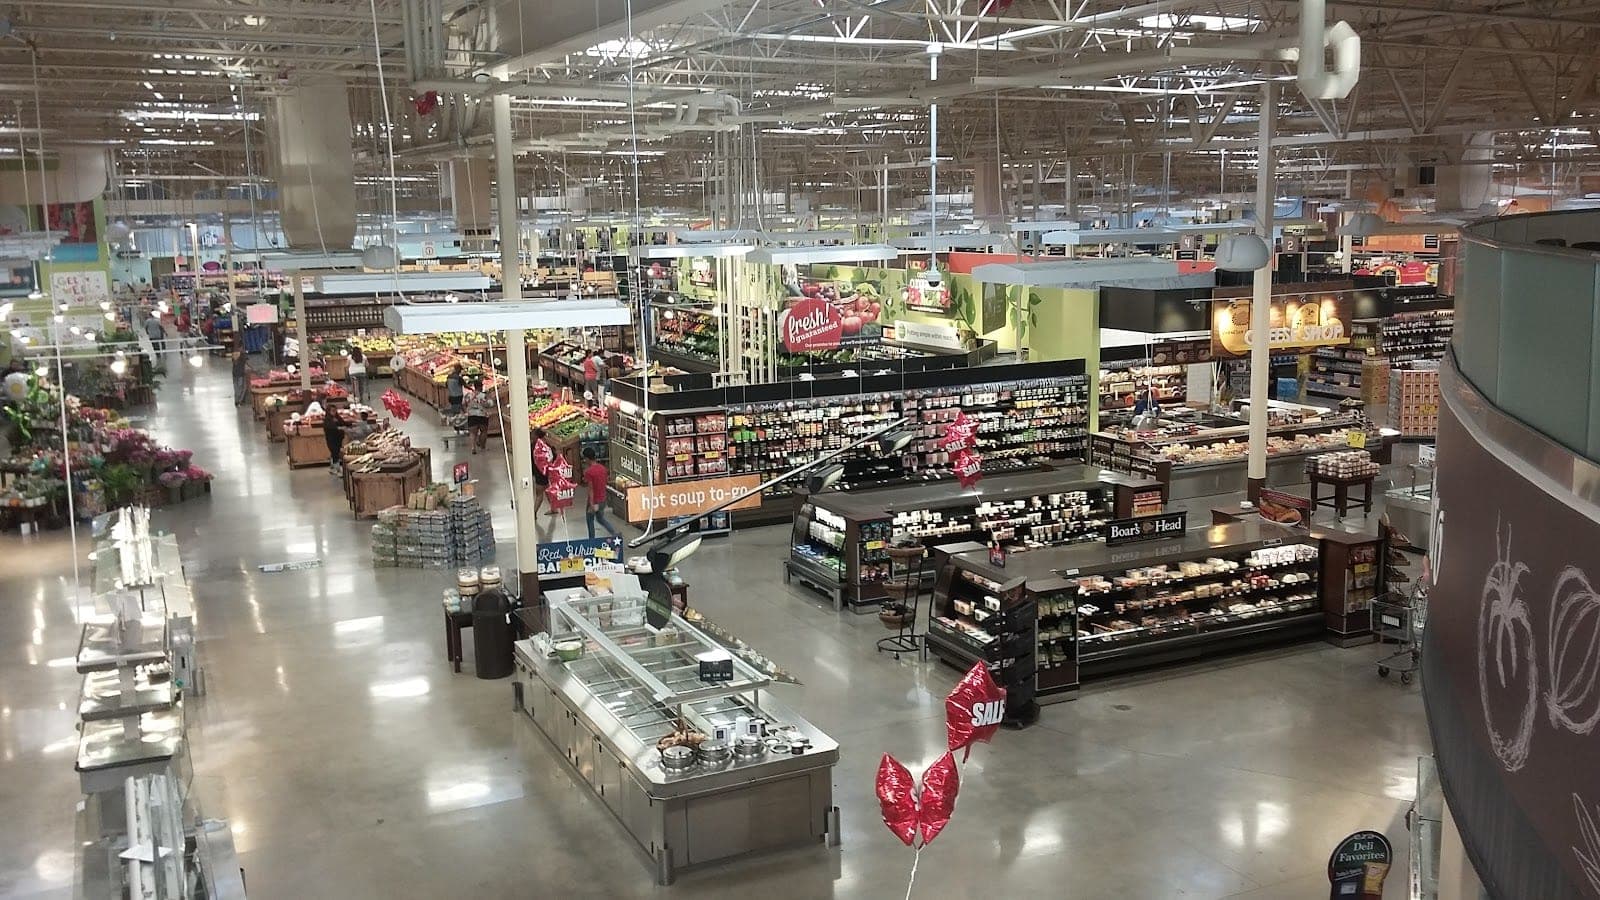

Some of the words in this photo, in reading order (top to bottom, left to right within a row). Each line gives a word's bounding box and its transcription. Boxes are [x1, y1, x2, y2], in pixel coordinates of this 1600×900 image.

[1184, 238, 1190, 248] 4
[1287, 240, 1293, 250] 2
[789, 303, 829, 343] fresh!
[796, 321, 838, 343] guaranteed
[1303, 324, 1342, 341] SHOP
[945, 440, 967, 453] SALE
[620, 455, 634, 472] salad
[633, 459, 642, 476] bar
[556, 488, 574, 500] SALE
[641, 493, 665, 510] hot
[670, 488, 705, 507] soup
[710, 486, 749, 500] to-go
[1111, 523, 1141, 538] Boar's
[1155, 517, 1182, 533] Head
[1353, 841, 1374, 851] Deli
[1339, 852, 1385, 862] Favorites
